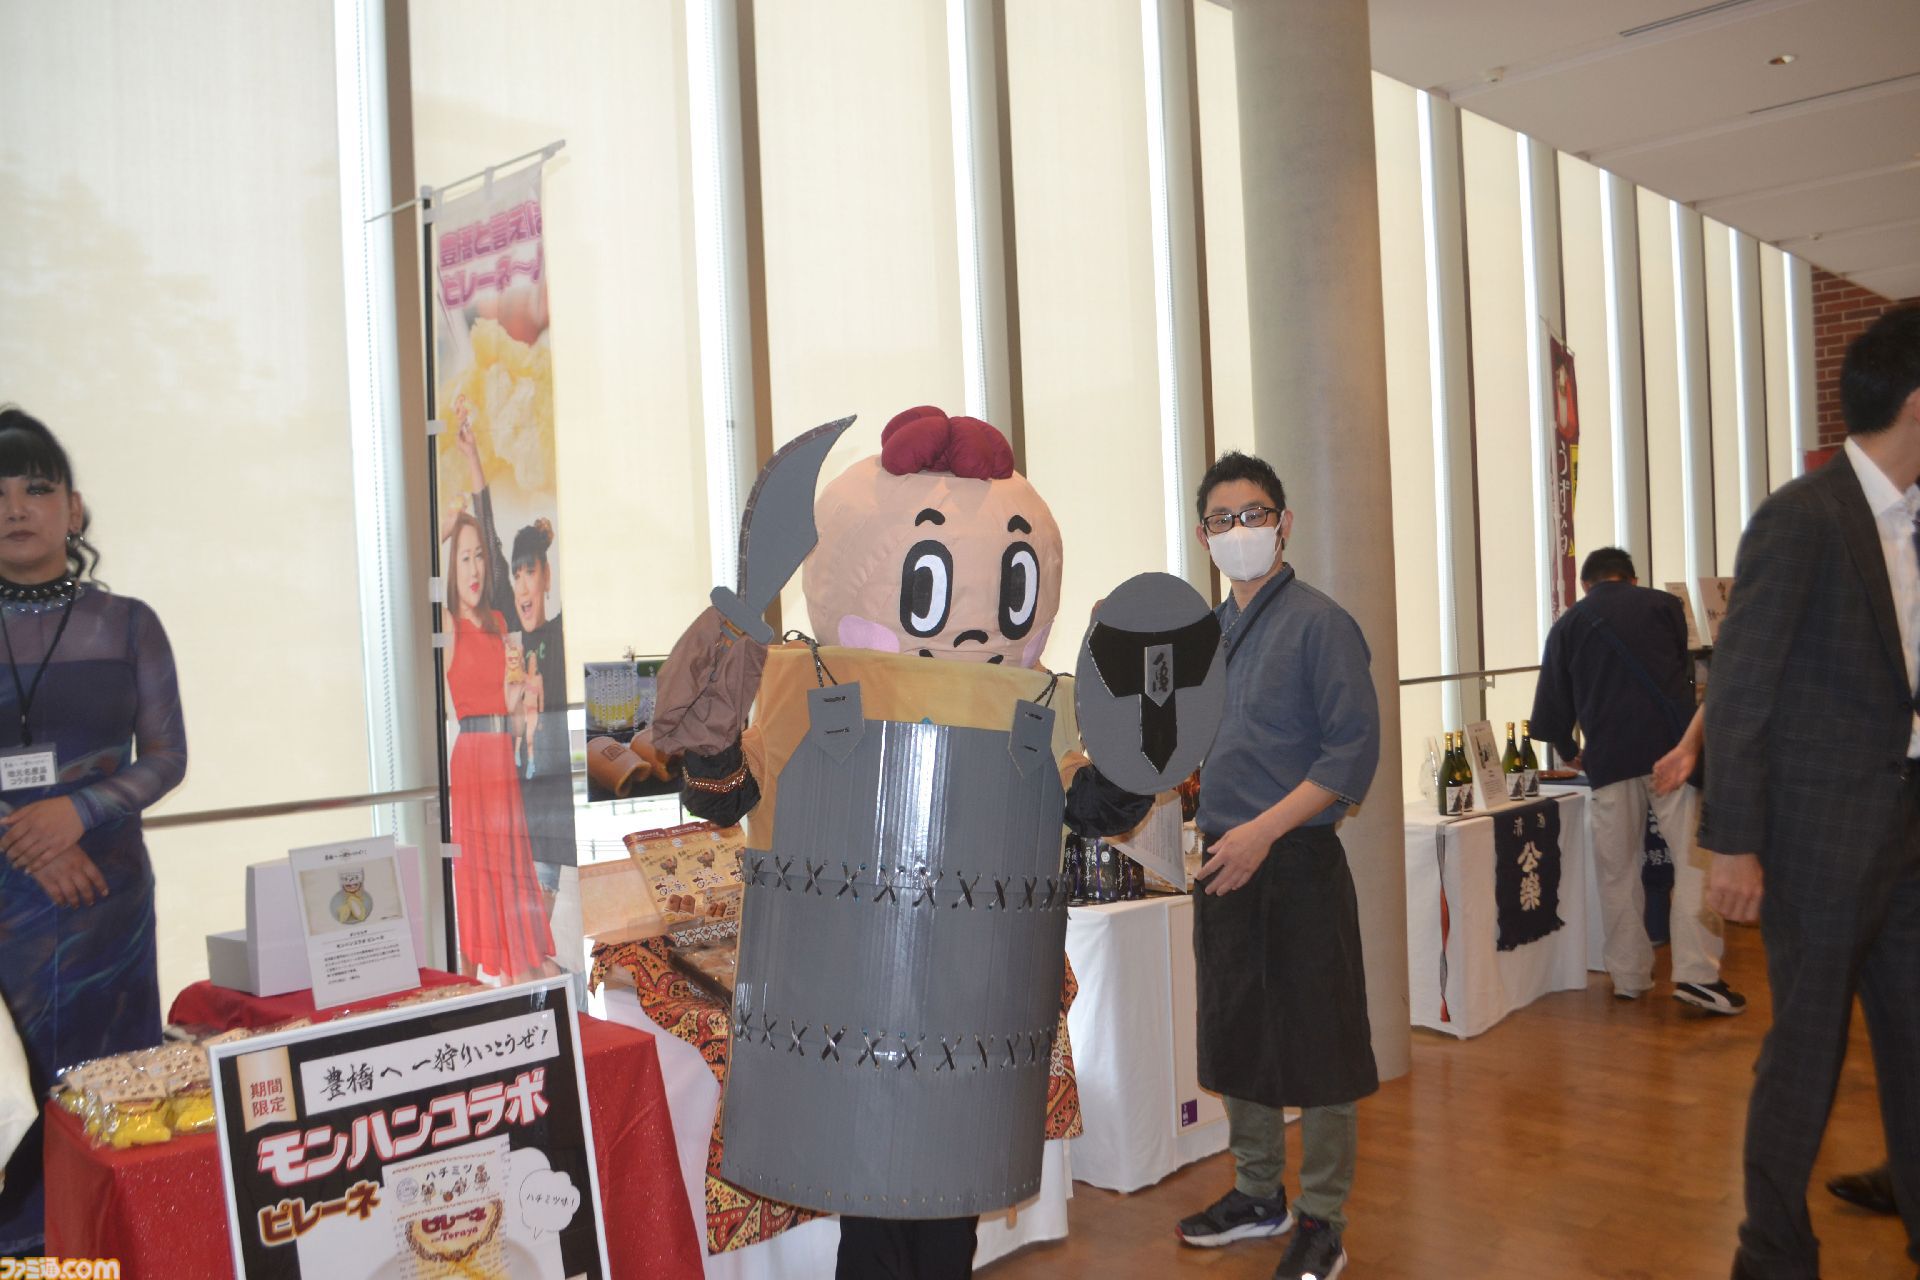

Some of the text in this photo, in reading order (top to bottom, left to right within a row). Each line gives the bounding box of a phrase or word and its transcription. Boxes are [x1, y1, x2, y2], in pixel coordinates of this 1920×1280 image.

[250, 1077, 283, 1099] 期間
[252, 1096, 287, 1118] 限定
[258, 1068, 549, 1186] モンハンコラボ
[426, 1163, 473, 1181] ハチミツ
[258, 1180, 381, 1247] ピレーネ
[421, 1206, 488, 1235] ピレーネ
